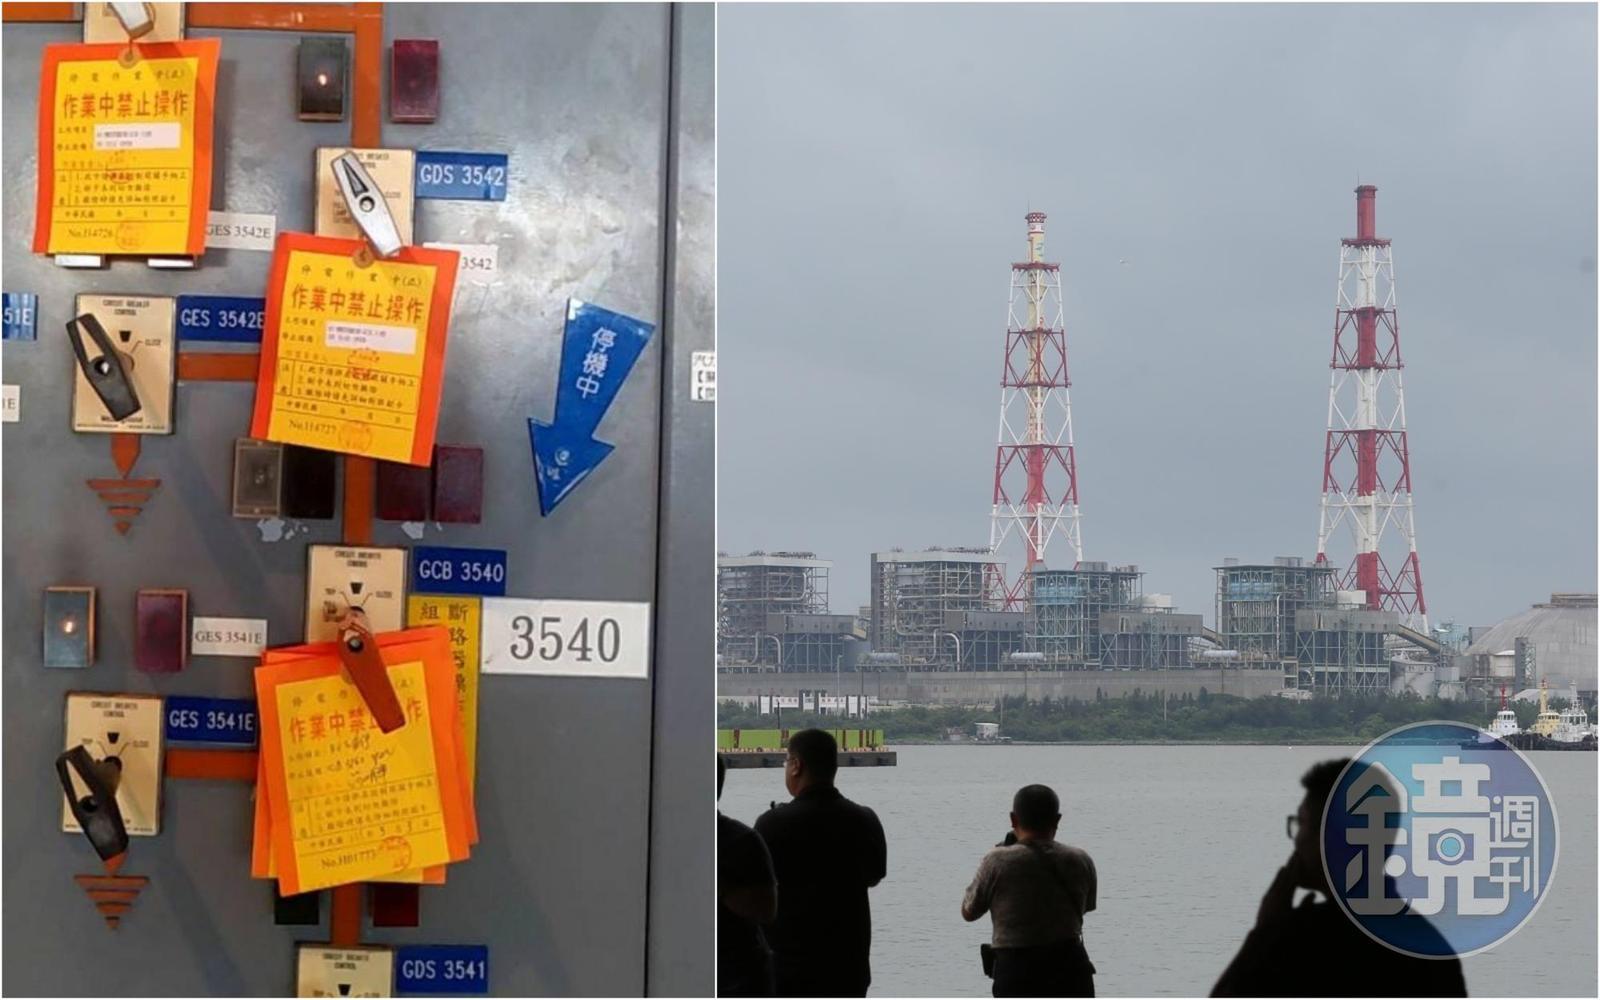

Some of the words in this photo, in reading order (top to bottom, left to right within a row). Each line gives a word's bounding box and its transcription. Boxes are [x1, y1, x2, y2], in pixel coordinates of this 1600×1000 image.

[64, 90, 189, 119] 作業中禁止操作
[420, 164, 454, 184] GDS
[461, 166, 505, 186] 3542
[234, 225, 272, 239] 3542E
[461, 257, 492, 270] 3542
[291, 284, 425, 324] 作業中禁止操作
[181, 308, 210, 327] GES
[218, 310, 265, 329] 3542E
[576, 327, 617, 399] 停機中
[419, 560, 452, 579] GCB
[460, 561, 504, 582] 3540
[195, 632, 222, 642] GES
[226, 632, 263, 645] 3541E
[509, 615, 621, 662] 3540
[169, 710, 199, 729] GES
[206, 713, 254, 732] 3541E
[288, 697, 422, 744] 作業中禁作
[402, 960, 436, 979] GDS
[444, 961, 485, 980] 3541
